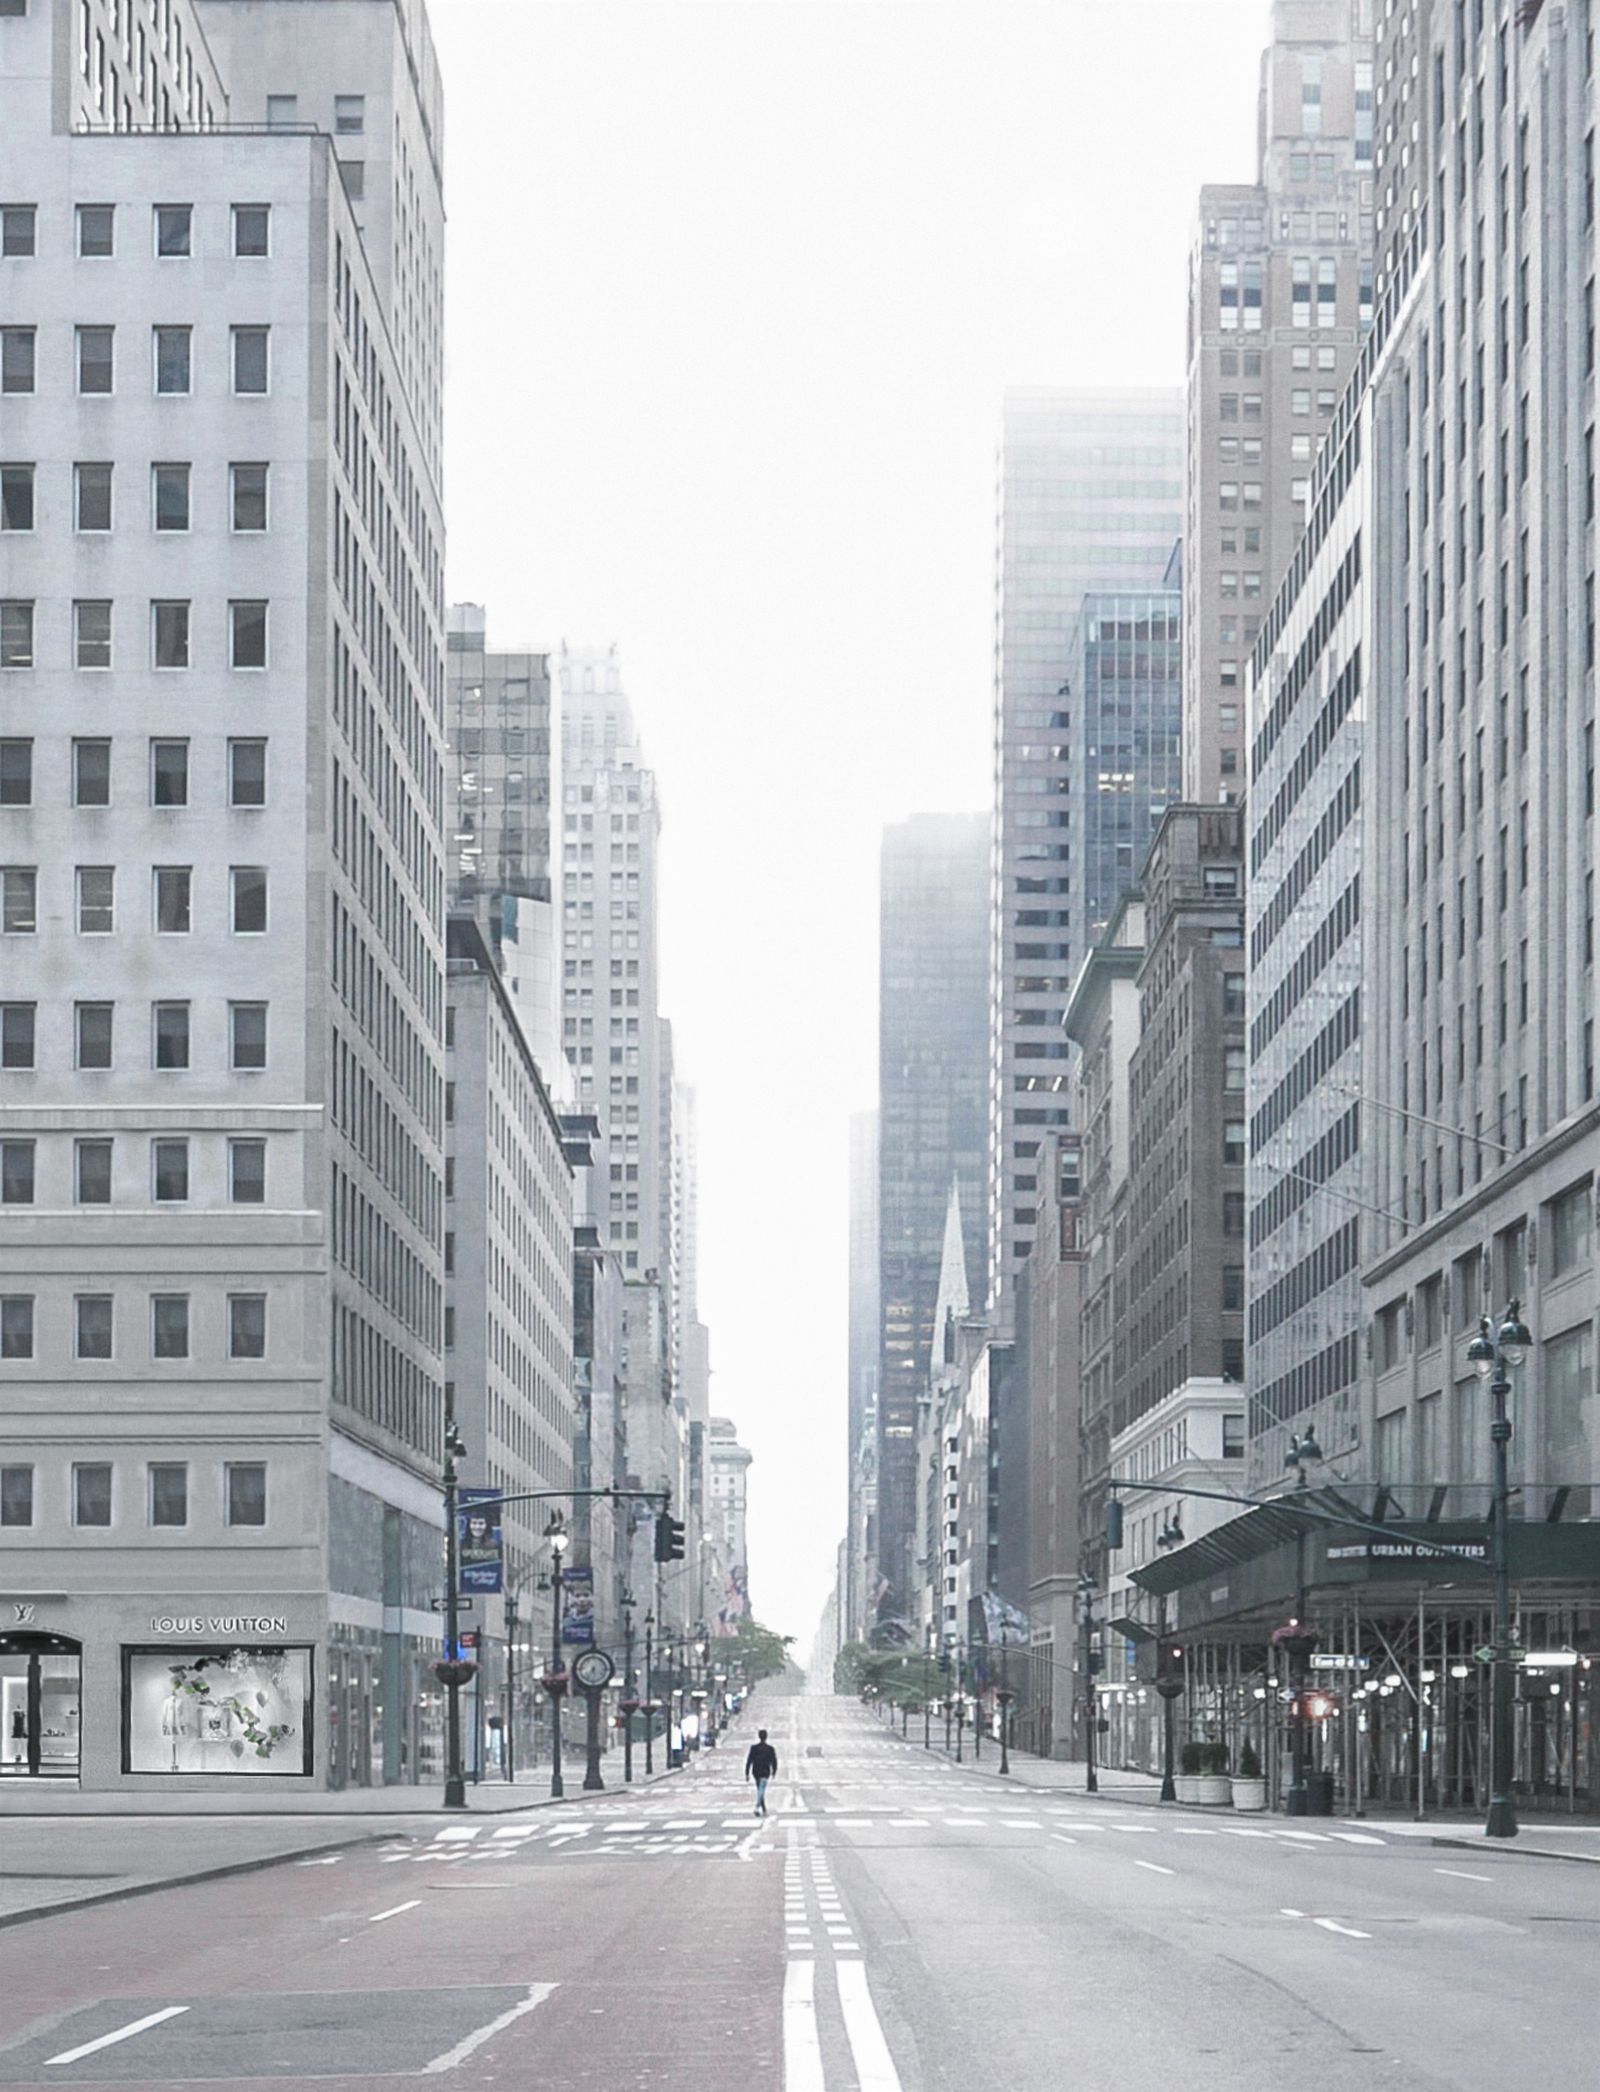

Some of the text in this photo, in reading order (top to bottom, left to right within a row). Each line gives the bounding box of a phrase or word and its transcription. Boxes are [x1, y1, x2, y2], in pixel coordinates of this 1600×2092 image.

[1371, 1544, 1413, 1557] URBAN
[1415, 1544, 1486, 1558] OUTTERS
[150, 1616, 287, 1632] LOUIS VUITTON
